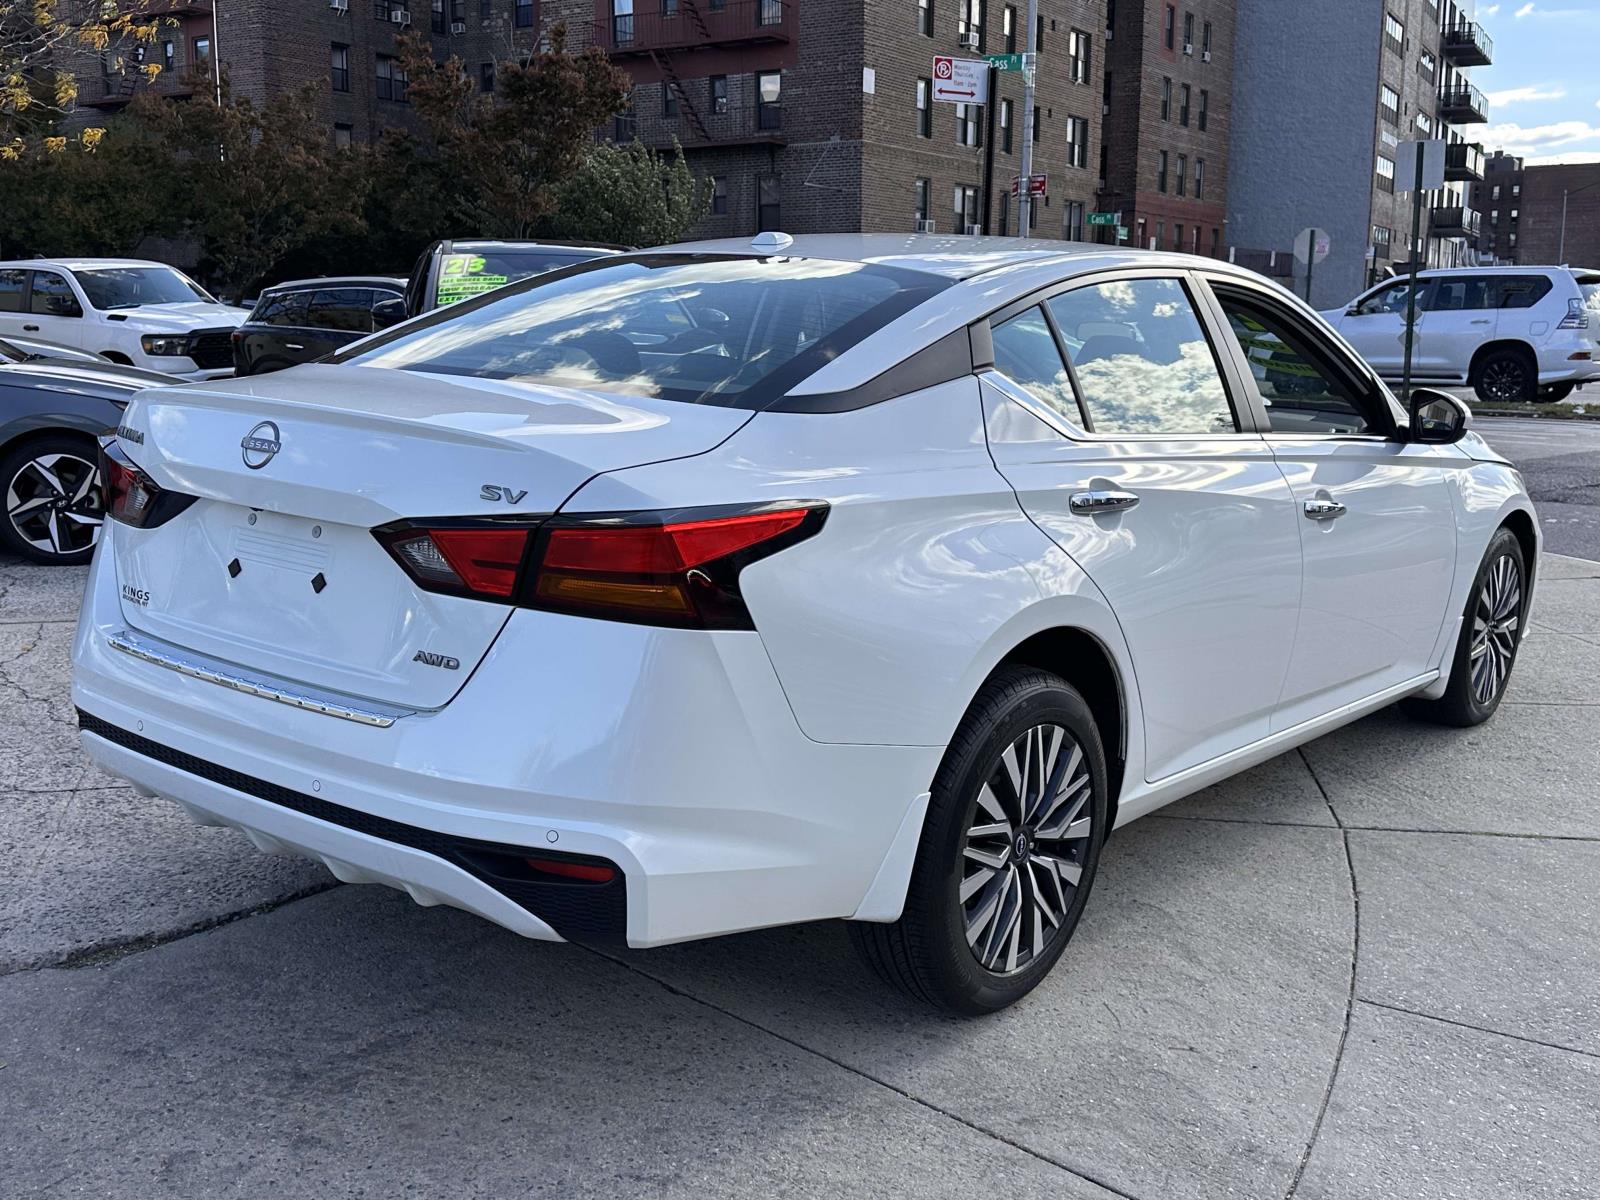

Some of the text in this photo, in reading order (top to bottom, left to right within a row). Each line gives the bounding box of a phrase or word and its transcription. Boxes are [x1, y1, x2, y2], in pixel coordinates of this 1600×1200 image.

[988, 57, 1008, 70] Cass
[1091, 214, 1105, 224] Cass
[446, 257, 487, 273] 23
[242, 439, 279, 451] SSAN
[480, 484, 529, 504] SV
[122, 584, 150, 602] KINGS
[412, 650, 460, 670] AWD
